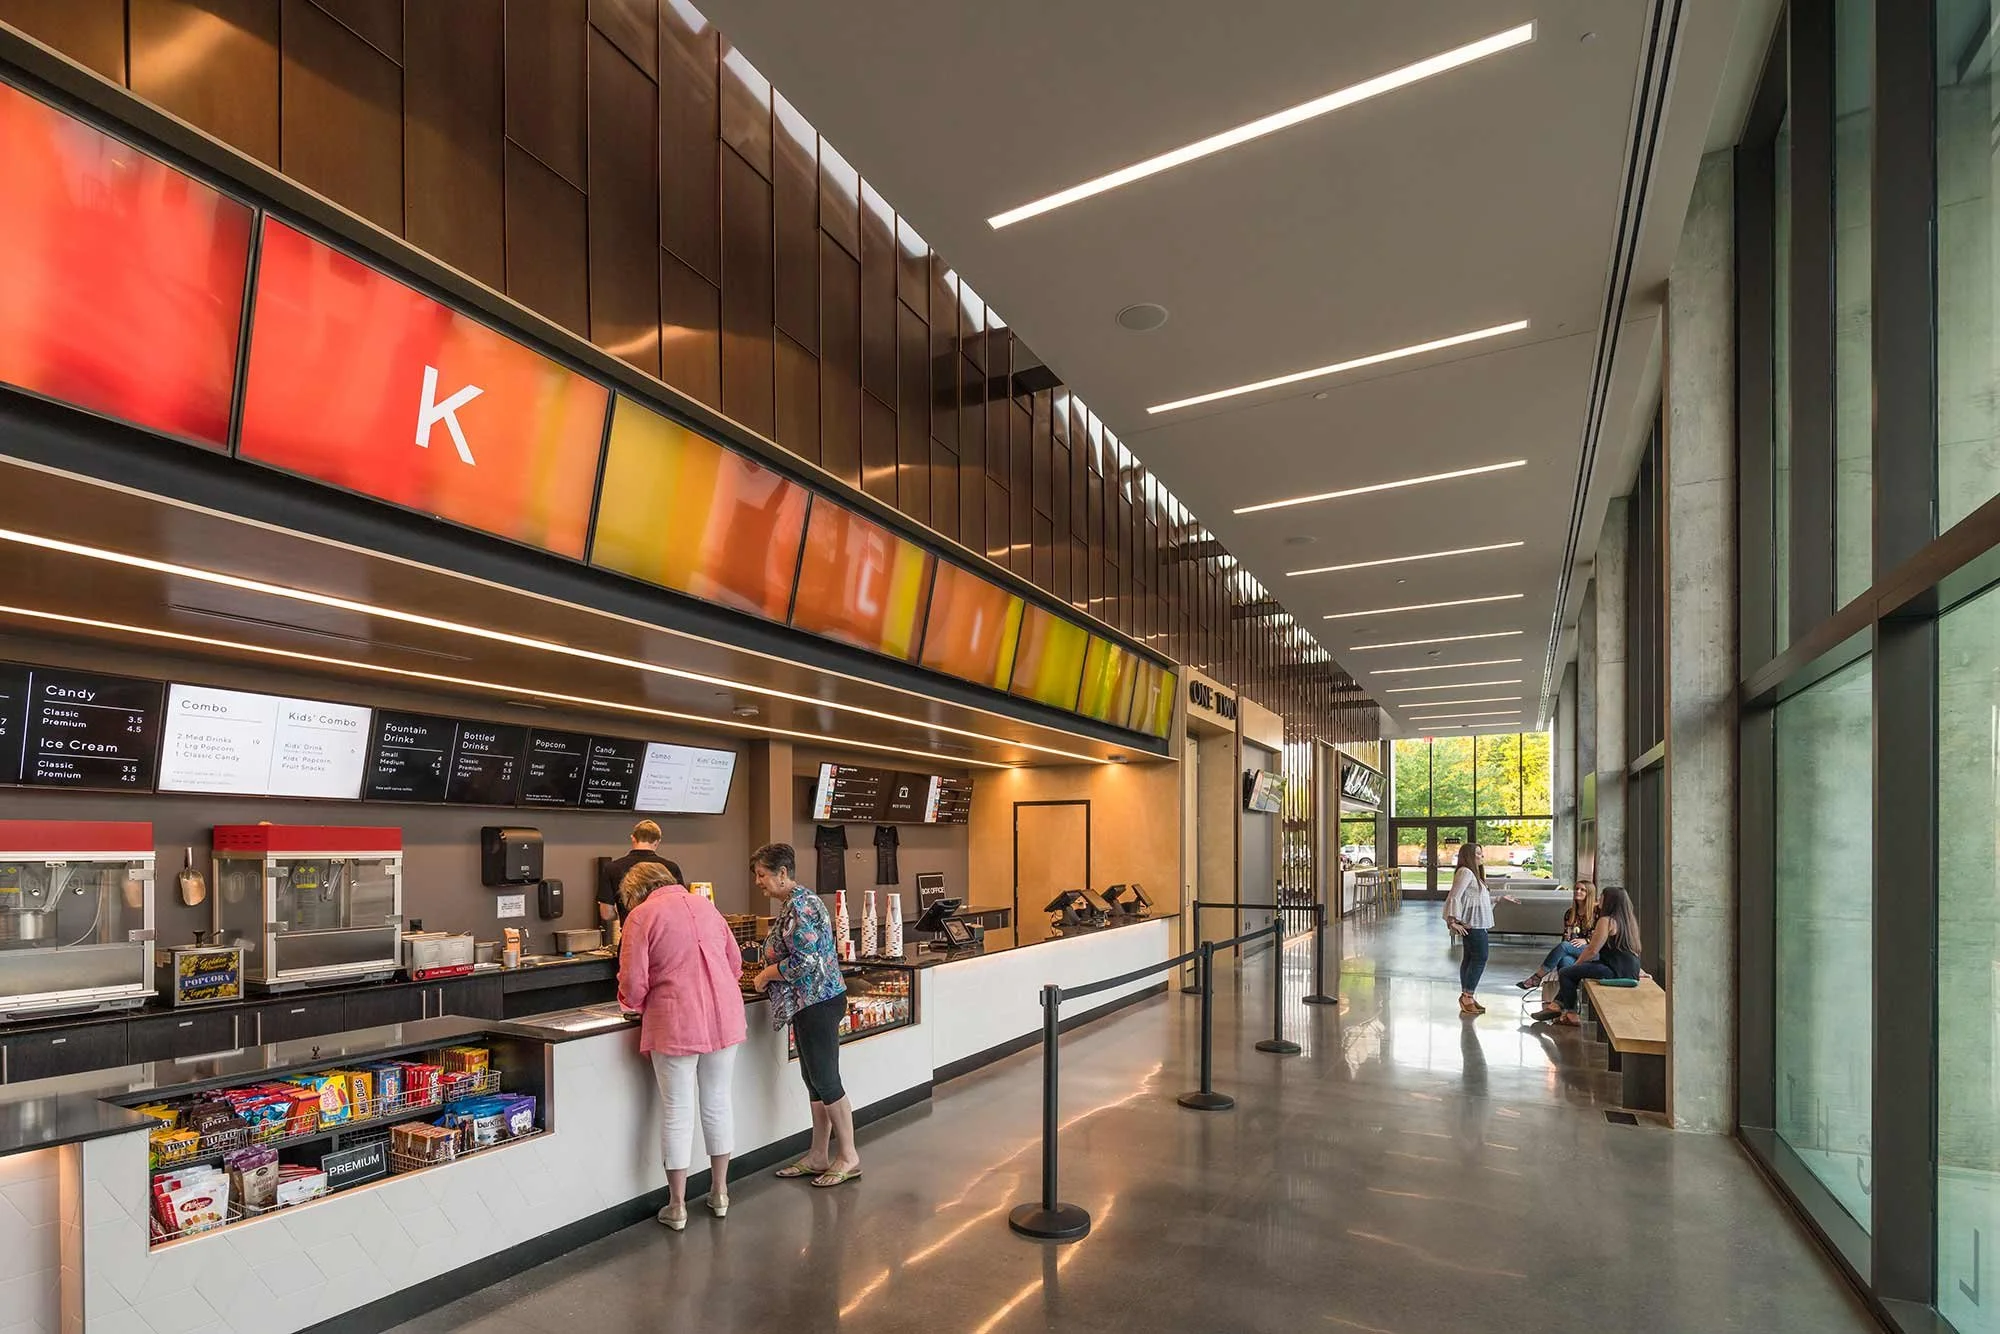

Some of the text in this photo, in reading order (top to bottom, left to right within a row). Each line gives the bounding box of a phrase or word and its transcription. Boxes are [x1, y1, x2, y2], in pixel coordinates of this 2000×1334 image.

[415, 364, 484, 466] K
[45, 685, 96, 701] Candy
[1189, 680, 1238, 720] ONE TWO
[181, 700, 228, 713] Combo
[43, 708, 143, 724] Classic 3.5
[288, 712, 357, 727] Kids' Combo
[42, 717, 142, 733] Premium 4.5
[385, 723, 427, 735] Fountain
[206, 735, 232, 743] Drinks
[383, 733, 414, 744] Drinks
[463, 731, 495, 742] Bottled
[40, 737, 118, 753] Ice Cream
[200, 743, 234, 752] Popcorn
[462, 741, 489, 751] Drinks
[535, 739, 566, 749] Popcorn
[381, 750, 399, 758] Small
[594, 745, 616, 756] Candy
[183, 751, 212, 760] Classic
[214, 754, 240, 762] Candy
[379, 758, 405, 766] Medium
[459, 757, 479, 765] Classic
[38, 760, 137, 773] Classic 3.5
[378, 766, 397, 774] Large
[458, 764, 483, 772] Premium
[37, 769, 136, 782] Premium 4.5
[588, 778, 622, 787] Ice Cream
[184, 974, 231, 987] POPCORN
[329, 1153, 380, 1177] PREMIUM
